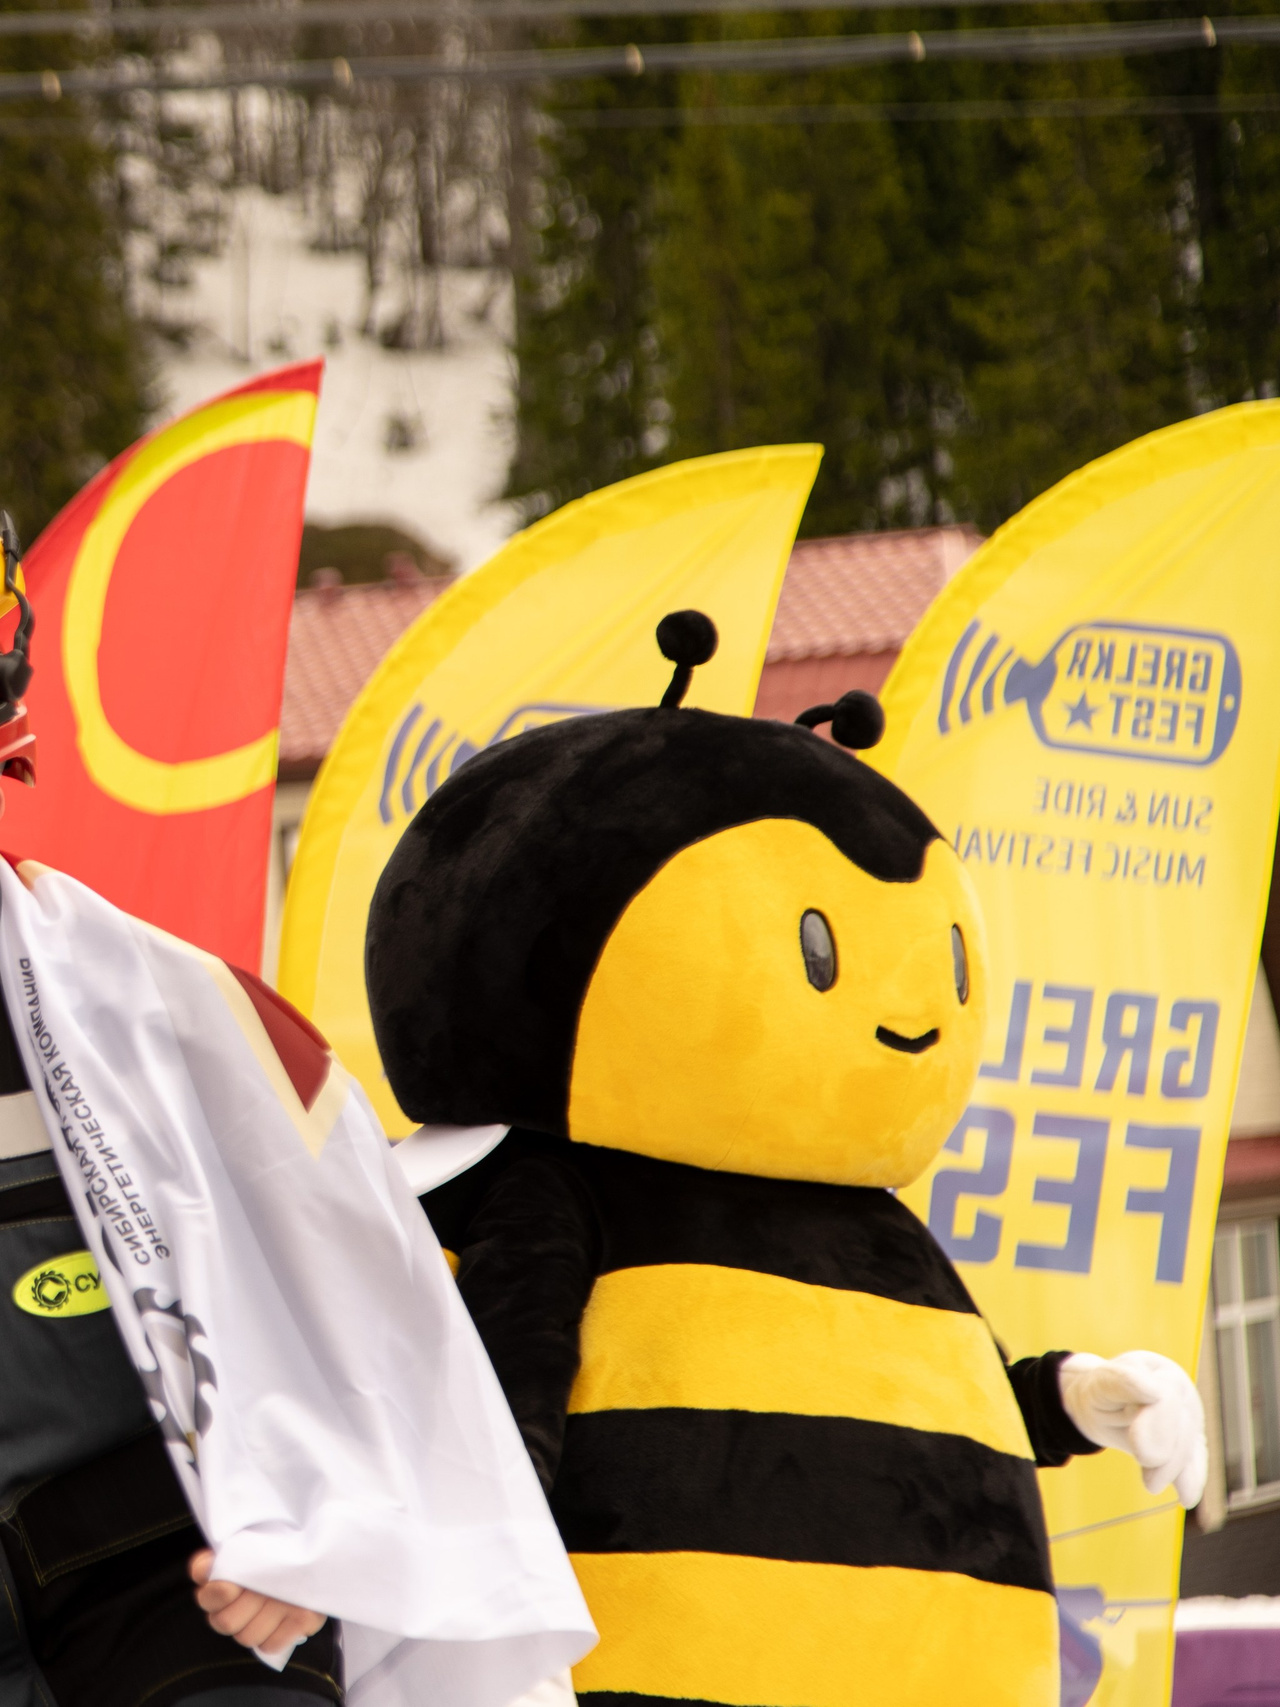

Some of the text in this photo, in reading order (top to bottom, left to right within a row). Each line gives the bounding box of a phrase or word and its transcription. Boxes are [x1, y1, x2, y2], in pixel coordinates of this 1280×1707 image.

[52, 1061, 171, 1260] ЭНЕРГЕТИЧЕСКАЯ
[72, 1138, 151, 1266] СИБИРСКАЯ
[74, 1270, 101, 1292] СУ
